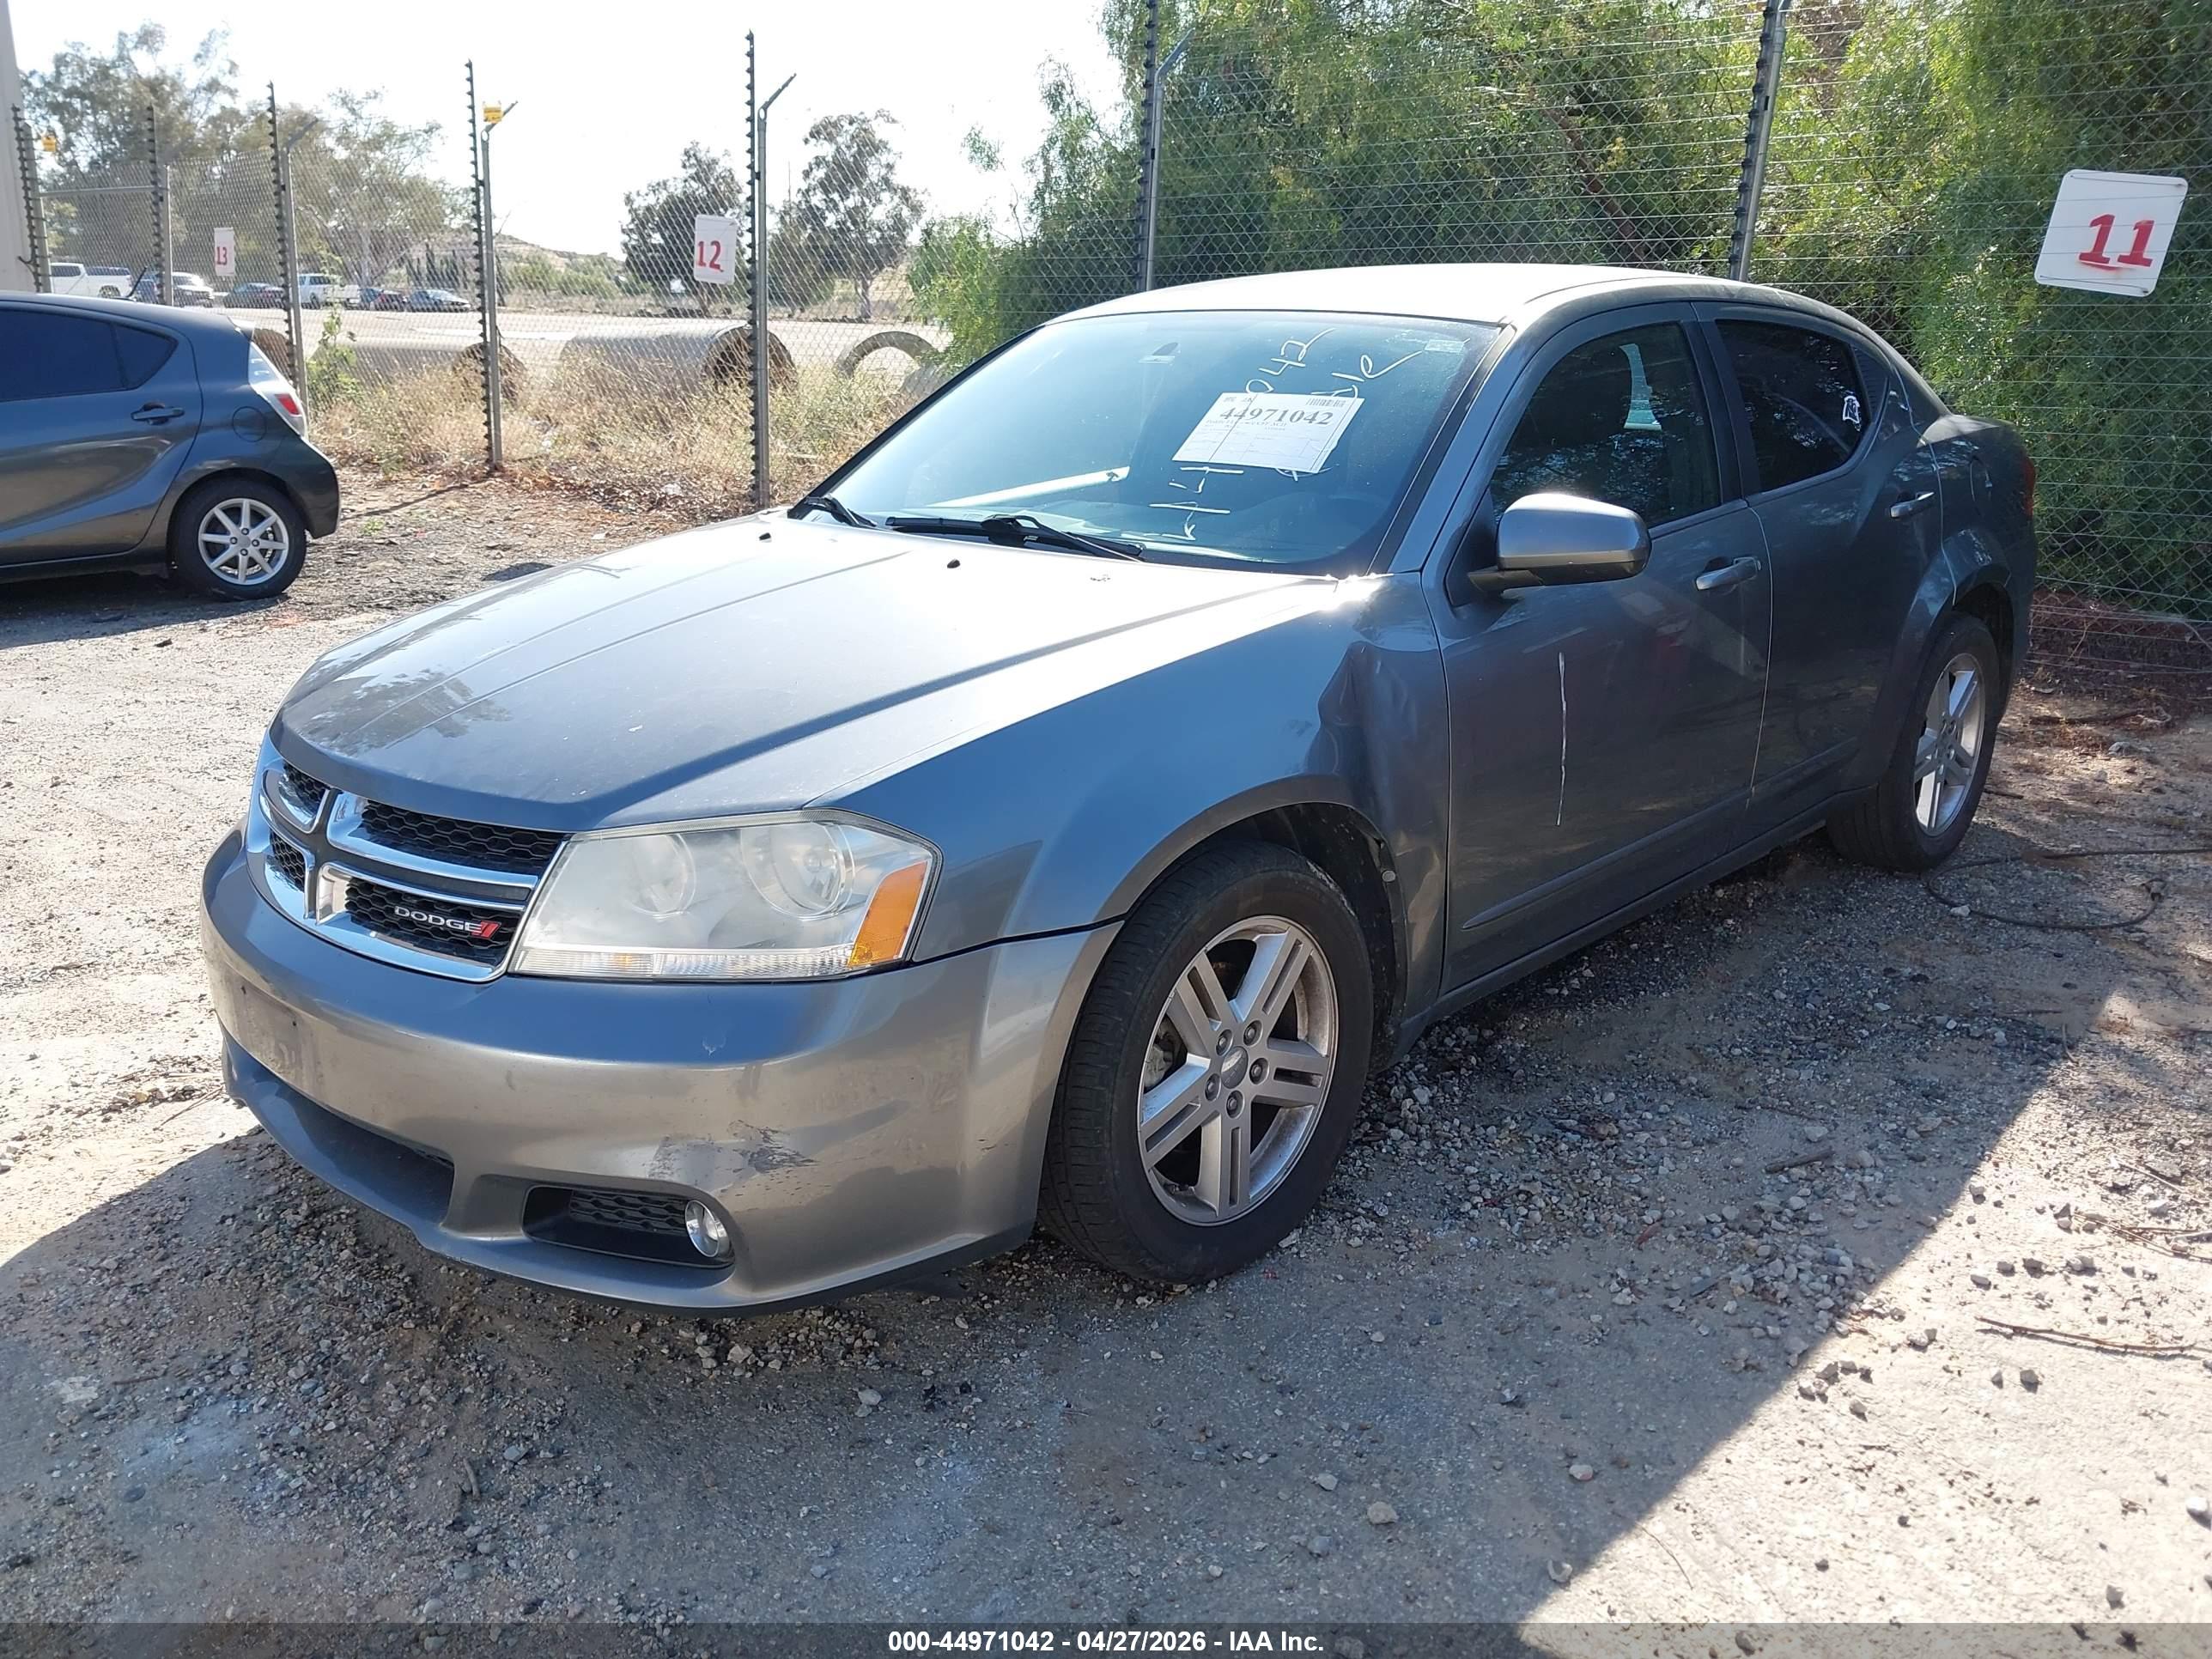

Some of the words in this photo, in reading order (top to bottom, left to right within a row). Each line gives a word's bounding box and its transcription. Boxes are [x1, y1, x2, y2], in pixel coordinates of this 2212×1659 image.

[2078, 214, 2155, 268] 11
[216, 246, 228, 265] 13
[696, 240, 723, 272] 12
[1219, 406, 1334, 426] 44971042
[394, 905, 483, 933] DODGE
